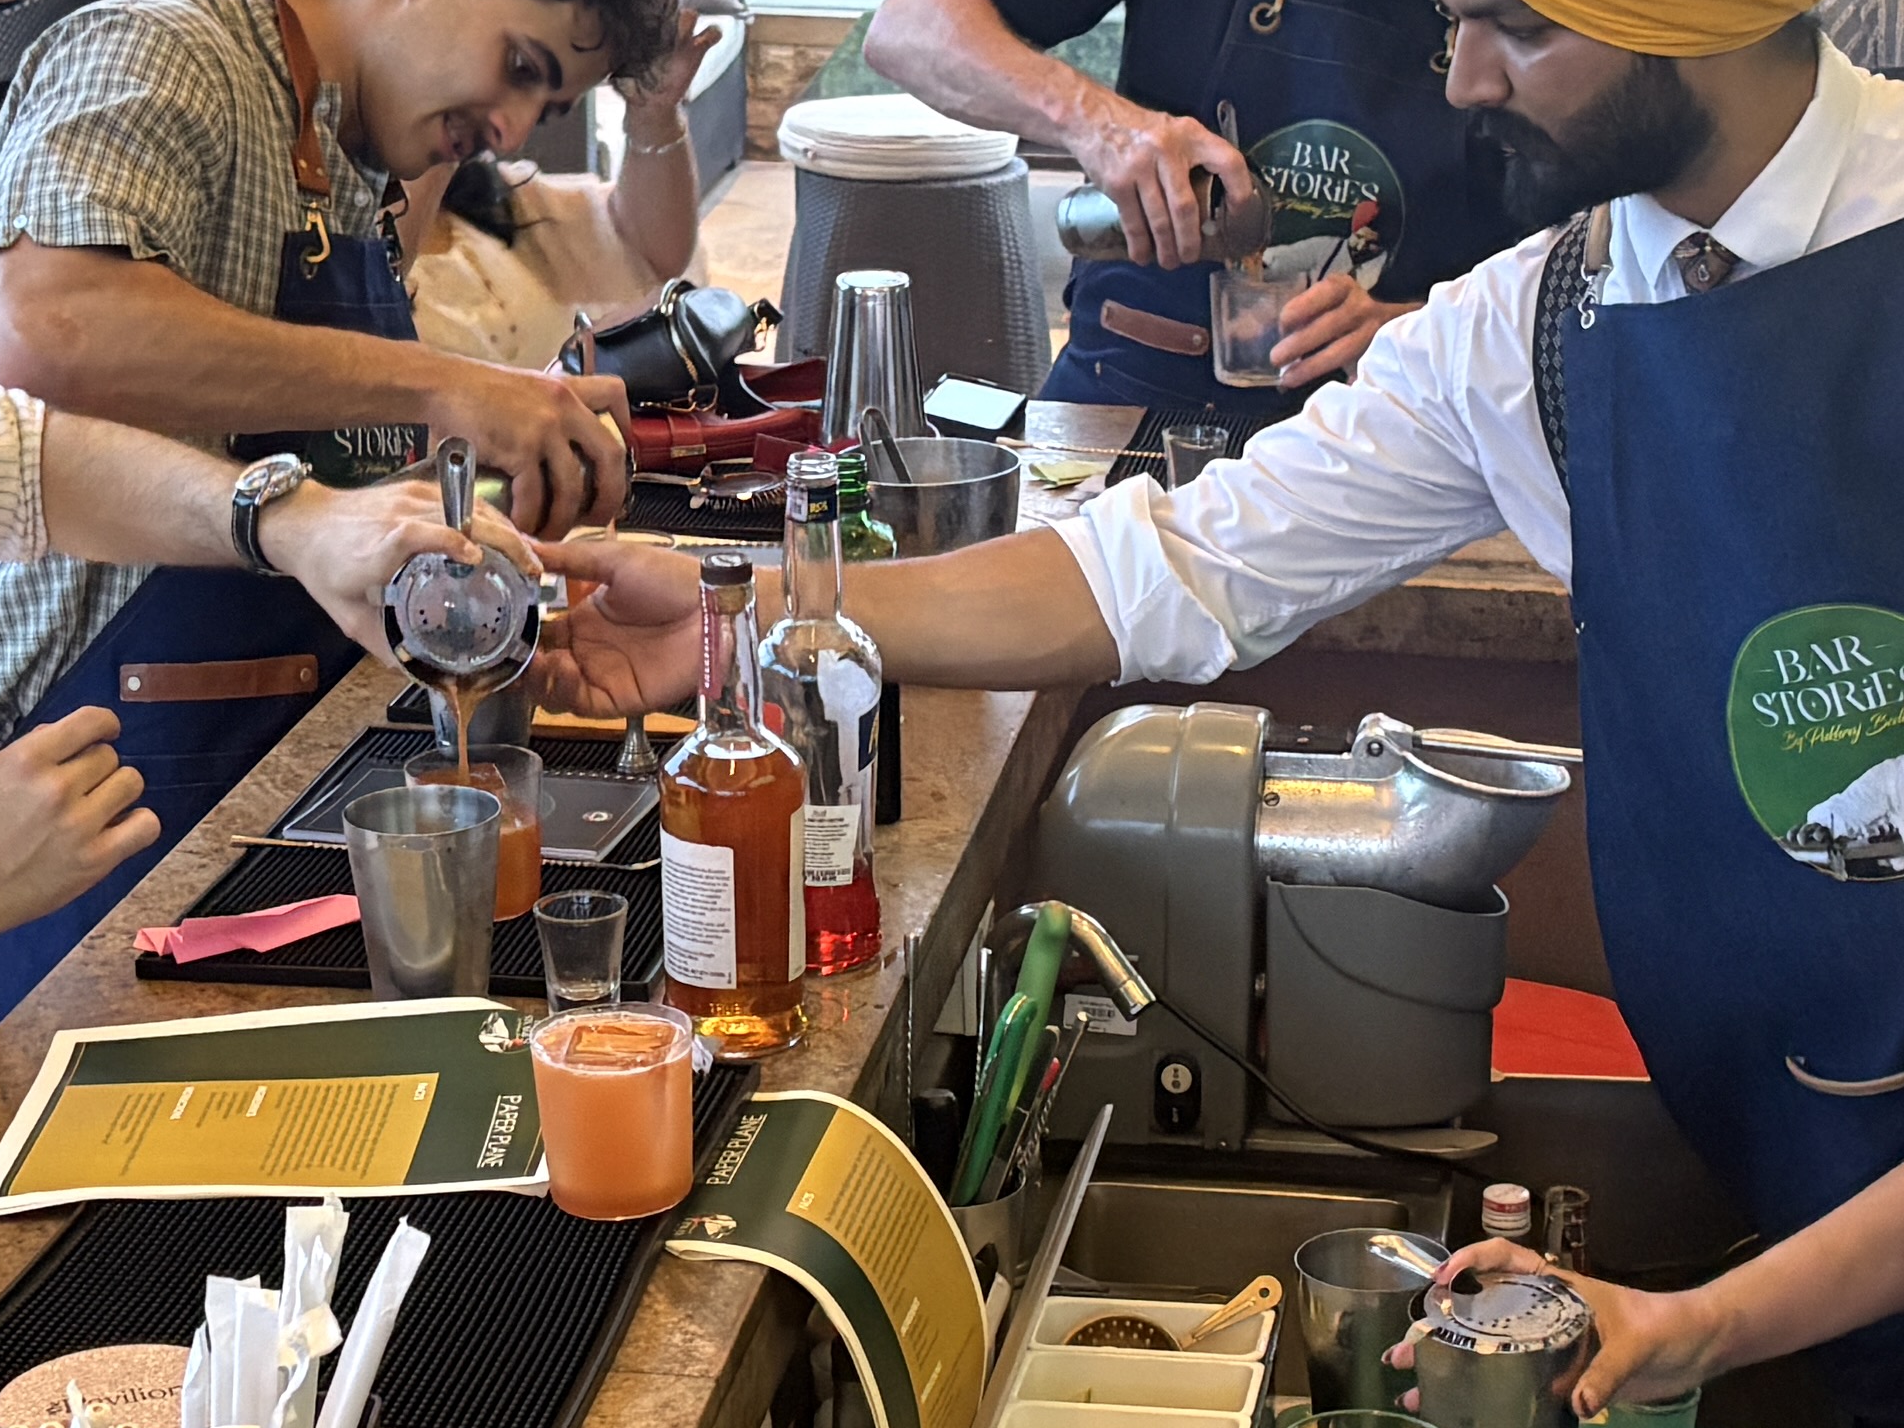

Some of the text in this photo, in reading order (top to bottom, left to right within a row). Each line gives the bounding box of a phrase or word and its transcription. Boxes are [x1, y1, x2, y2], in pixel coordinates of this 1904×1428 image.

[1292, 141, 1351, 176] BAR
[1773, 635, 1874, 685] BAR
[480, 1095, 522, 1168] PAPER PLANE
[706, 1114, 764, 1185] PAPER PLANE
